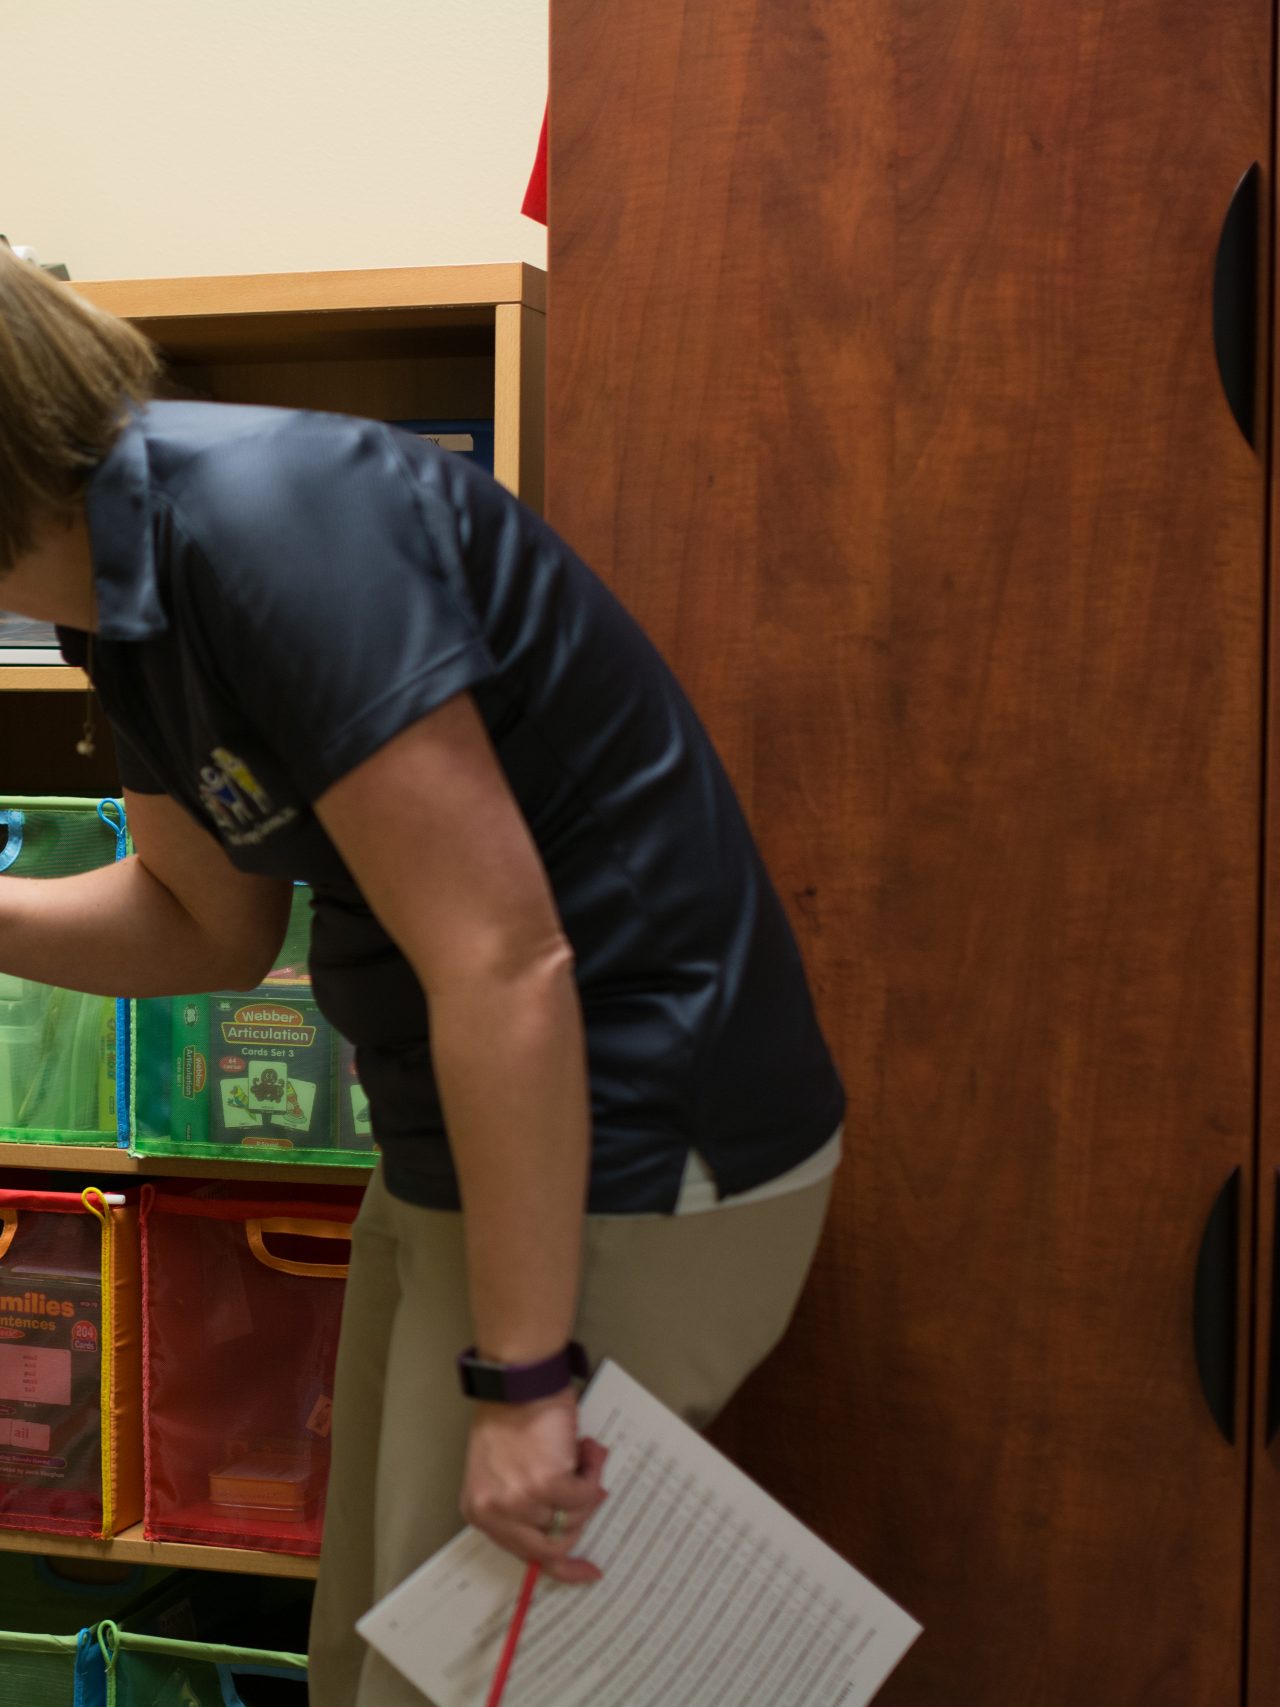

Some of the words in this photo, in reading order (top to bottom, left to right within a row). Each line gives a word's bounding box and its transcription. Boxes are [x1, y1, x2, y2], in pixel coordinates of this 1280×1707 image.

[242, 1009, 295, 1023] Webber
[228, 1027, 309, 1042] Articulation
[241, 1047, 268, 1056] Cards
[271, 1049, 285, 1057] Set
[288, 1049, 295, 1058] 3
[185, 1048, 193, 1096] Articulation
[14, 1428, 29, 1440] ail
